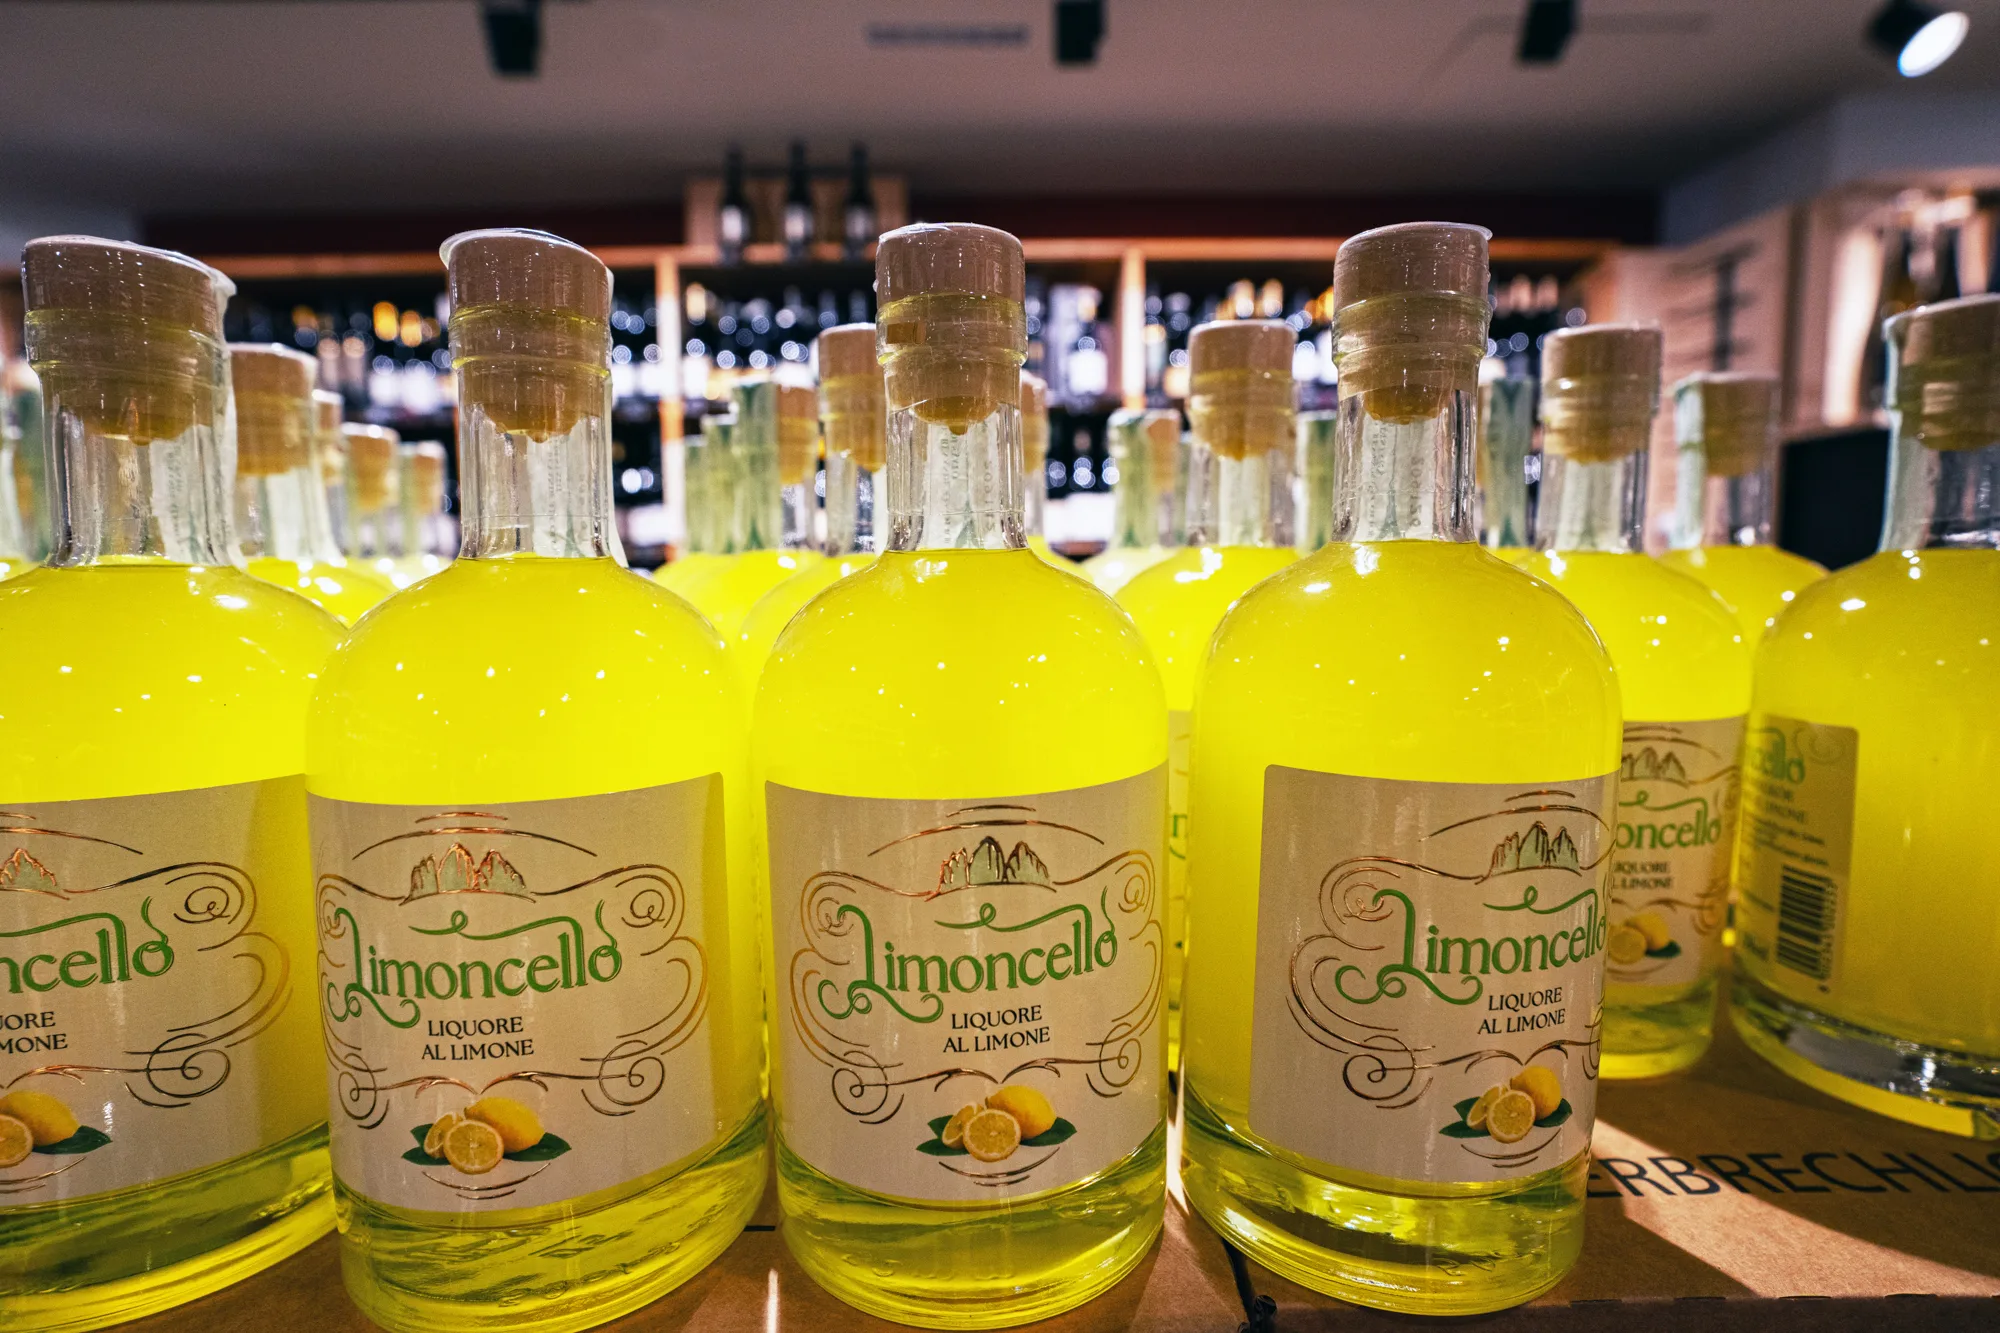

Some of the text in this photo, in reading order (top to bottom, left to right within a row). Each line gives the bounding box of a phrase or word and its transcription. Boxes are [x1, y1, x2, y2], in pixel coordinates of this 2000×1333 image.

[818, 886, 1118, 1023] Limoncello
[1335, 886, 1606, 1005] Limoncello
[327, 900, 622, 1028] Limoncello
[1488, 987, 1562, 1012] LIQUORE
[427, 1016, 524, 1040] LIQUORE
[951, 1005, 1042, 1031] LIQUORE
[1477, 1008, 1566, 1034] AL LIMONE
[421, 1039, 535, 1060] AL LIMONE
[943, 1026, 1050, 1052] AL LIMONE
